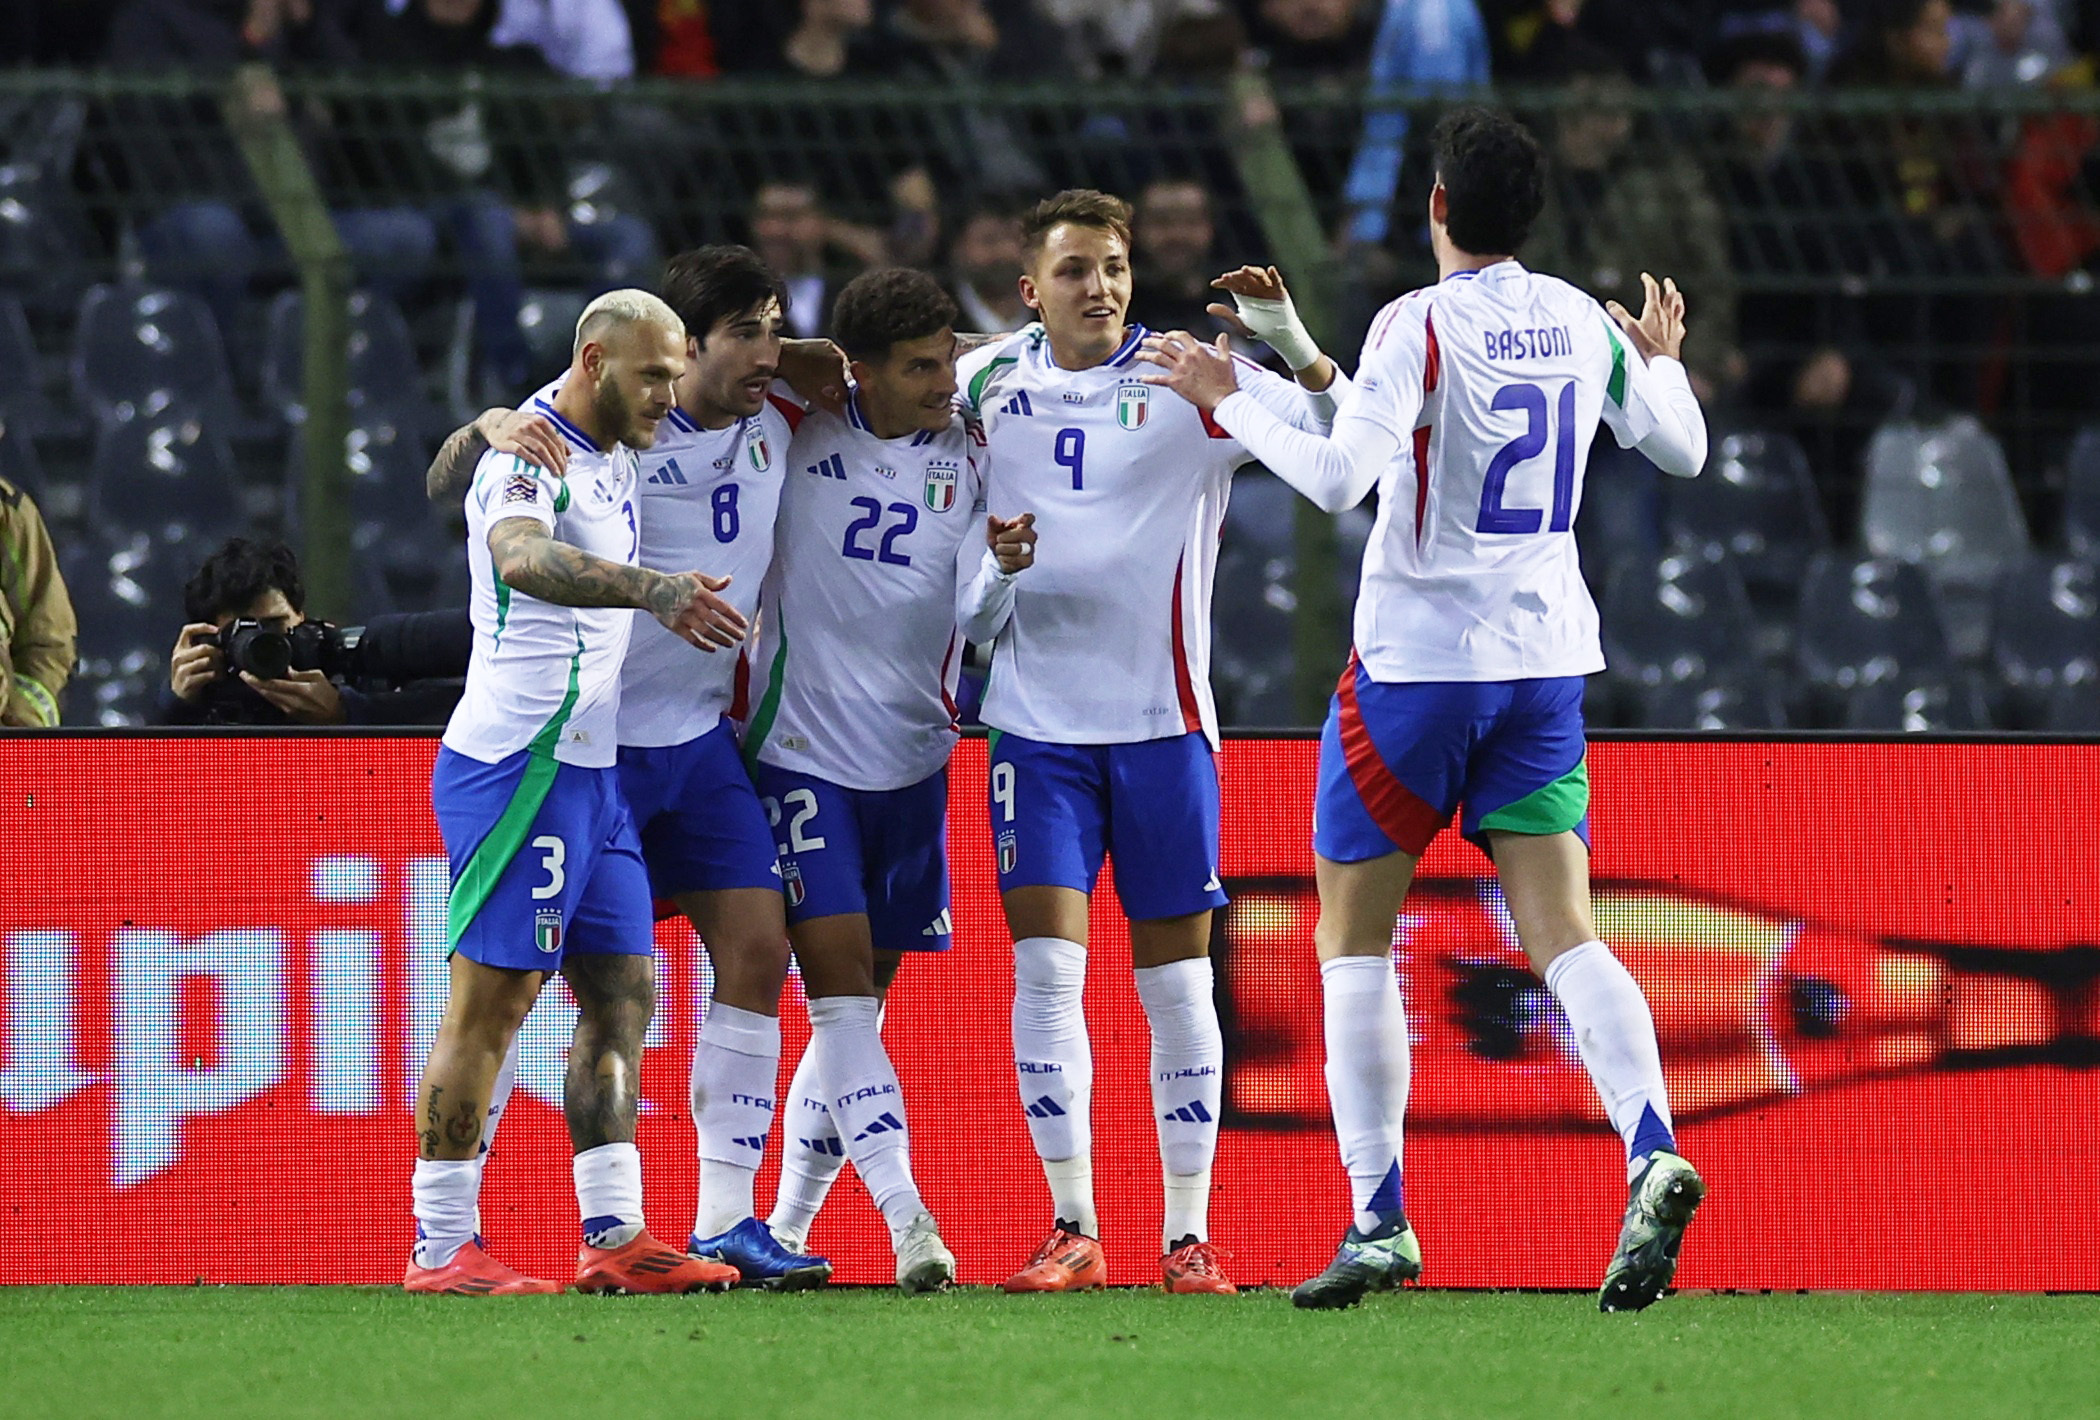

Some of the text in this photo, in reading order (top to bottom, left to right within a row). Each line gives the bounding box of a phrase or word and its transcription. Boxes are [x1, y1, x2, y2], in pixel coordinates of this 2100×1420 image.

[1484, 325, 1573, 361] BASTONI
[1119, 388, 1146, 399] ITALIA
[1054, 427, 1085, 491] 9
[1475, 380, 1575, 534] 21
[927, 470, 955, 482] ITALIA
[711, 483, 740, 544] 8
[842, 496, 919, 566] 22
[992, 762, 1016, 822] 9
[531, 835, 566, 900] 3
[538, 917, 560, 926] ITALIA
[1016, 1061, 1062, 1074] ALIA
[1160, 1065, 1216, 1082] ITALIA
[837, 1084, 896, 1109] ITALIA
